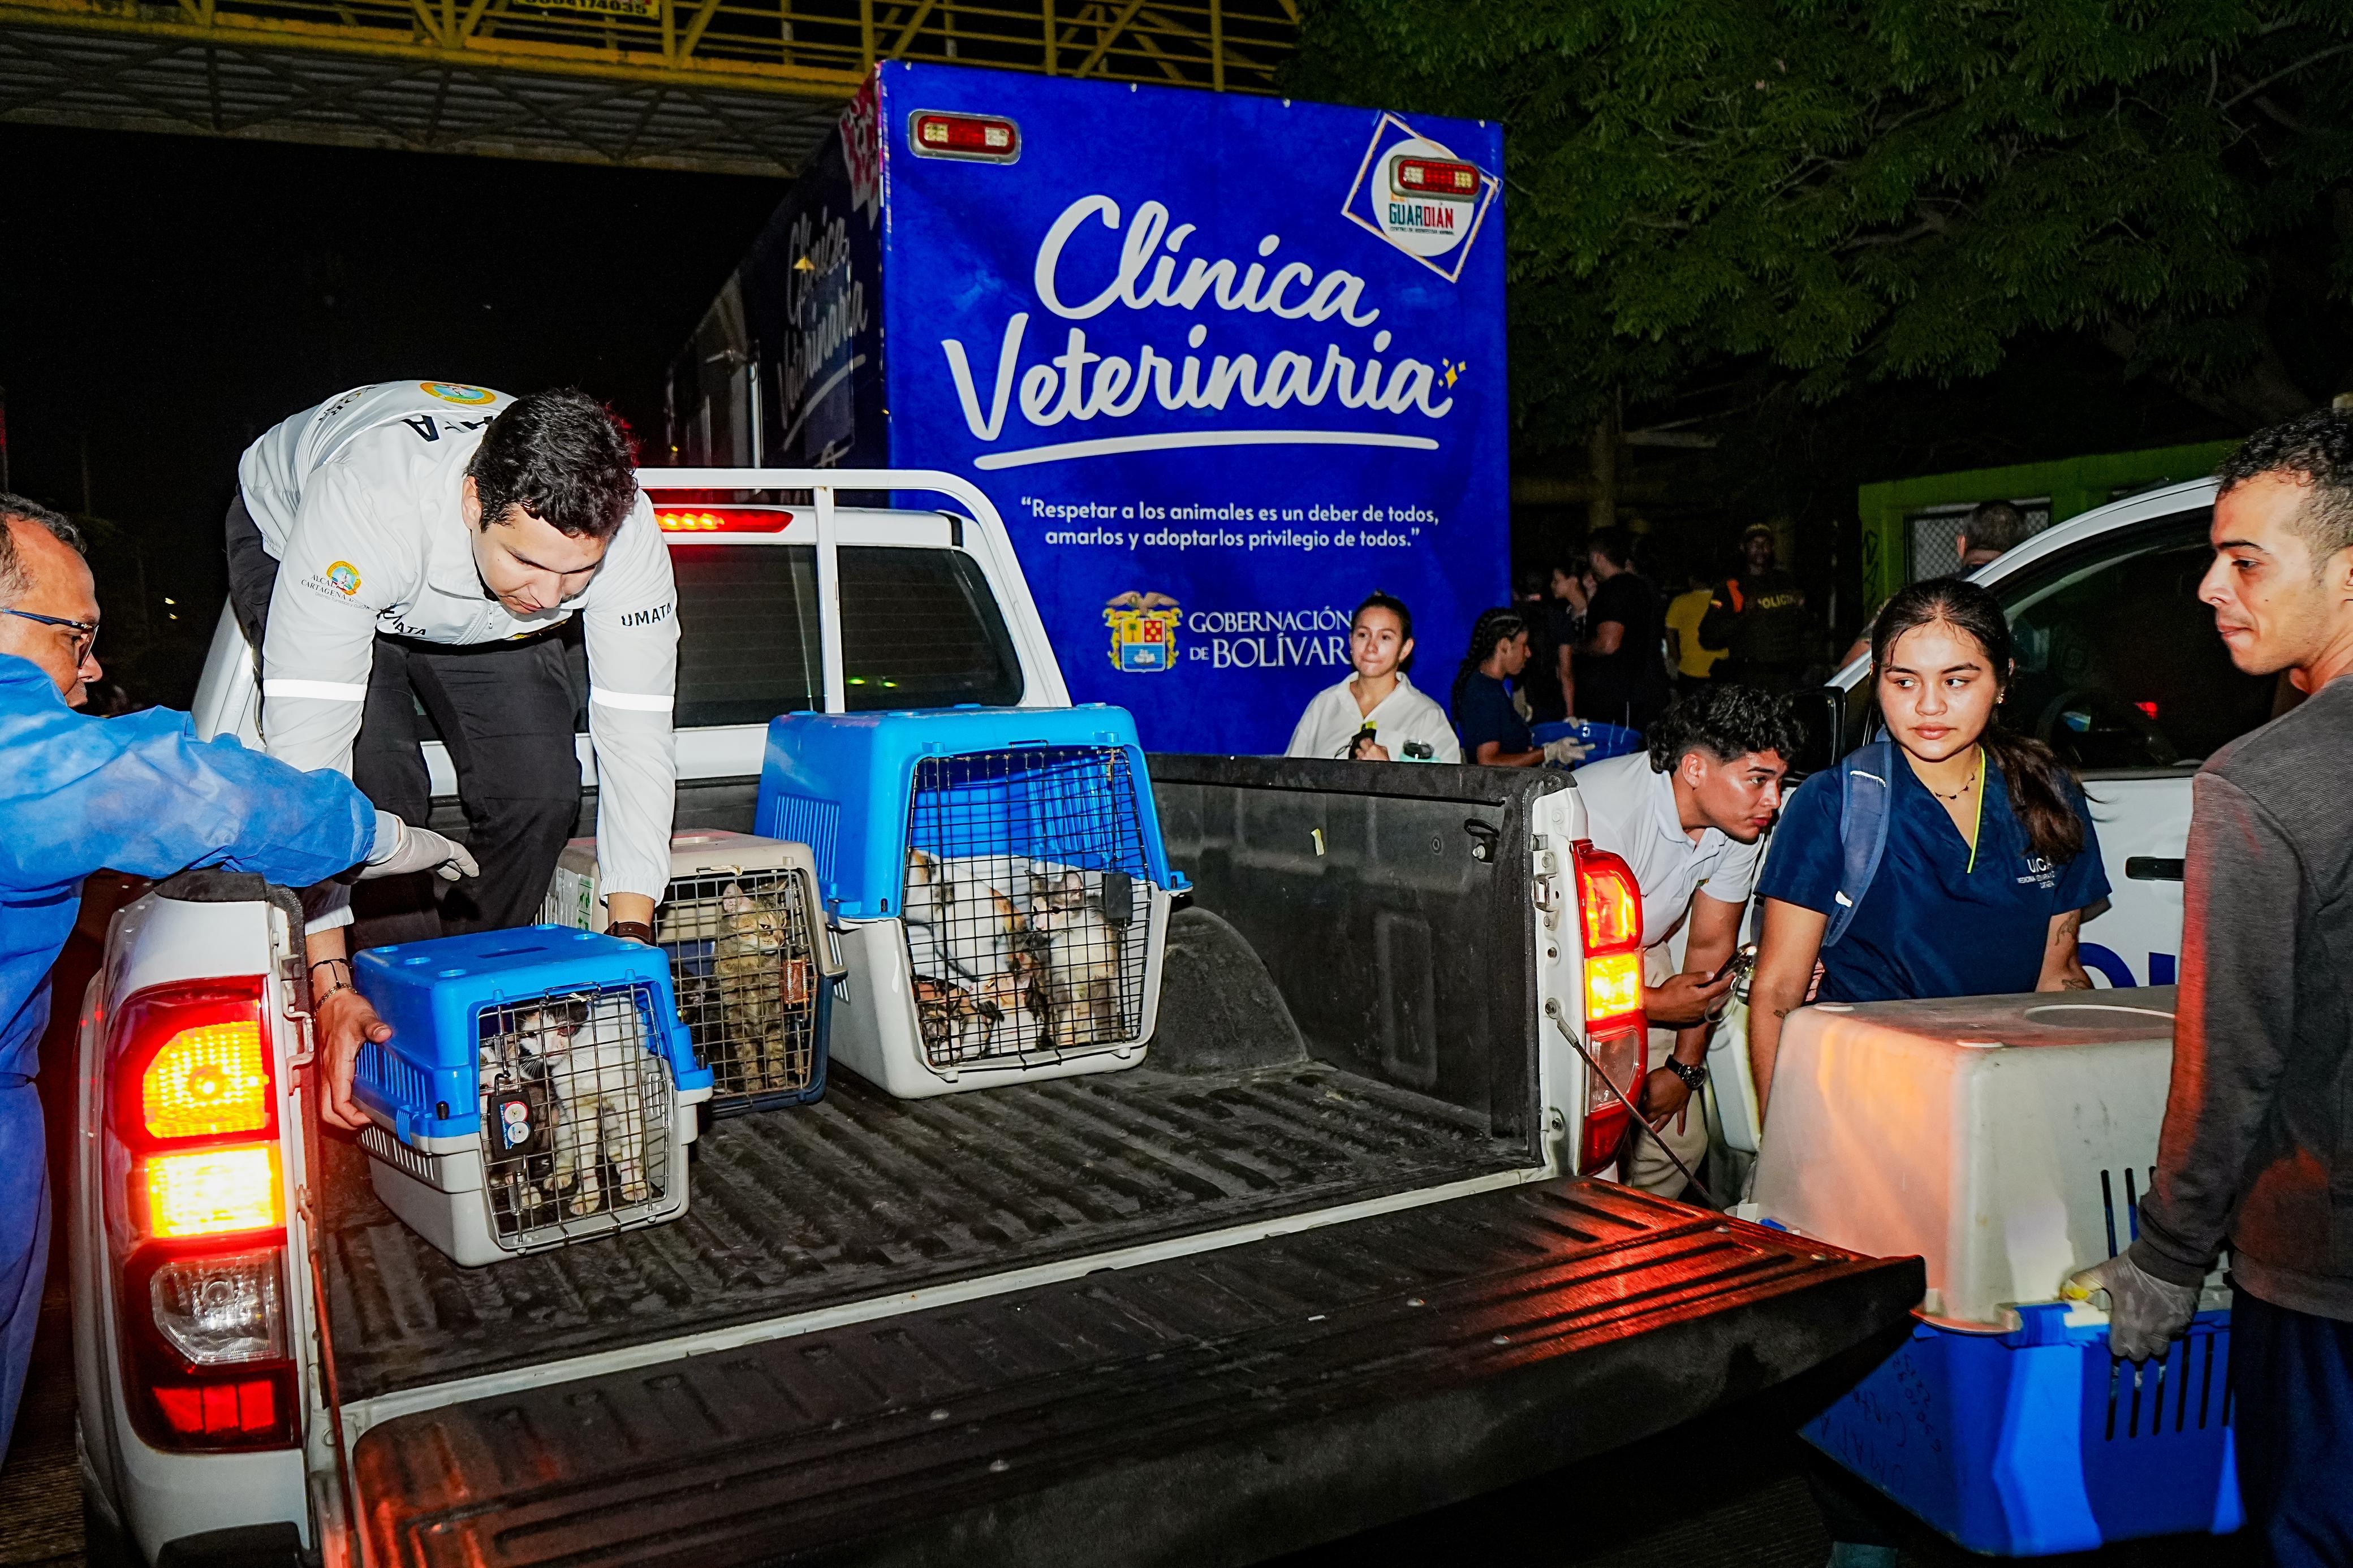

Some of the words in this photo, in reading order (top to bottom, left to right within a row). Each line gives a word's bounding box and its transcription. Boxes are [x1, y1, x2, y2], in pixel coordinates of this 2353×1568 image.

[1034, 194, 1380, 327] Clínica
[941, 313, 1453, 442] Veterinaria
[1022, 496, 1117, 523] “Respetar
[1122, 506, 1134, 519] a
[1139, 500, 1165, 520] los
[1170, 502, 1253, 520] animales
[1259, 508, 1278, 521] es
[1282, 509, 1303, 521] un
[1308, 503, 1358, 522] deber
[1362, 504, 1384, 522] de
[1388, 504, 1438, 526] todos,
[1045, 526, 1123, 546] amarlos
[1128, 533, 1139, 551] y
[1143, 527, 1244, 551] adoptarlos
[1248, 529, 1329, 551] privilegio
[1334, 529, 1355, 547] de
[1359, 527, 1420, 547] todos.”
[301, 579, 346, 600] CARTAGENA
[621, 602, 671, 626] UMATA
[1188, 605, 1352, 633] GOBERNACIÓN
[1190, 647, 1209, 660] DE
[1213, 632, 1352, 668] BOLÍVAR
